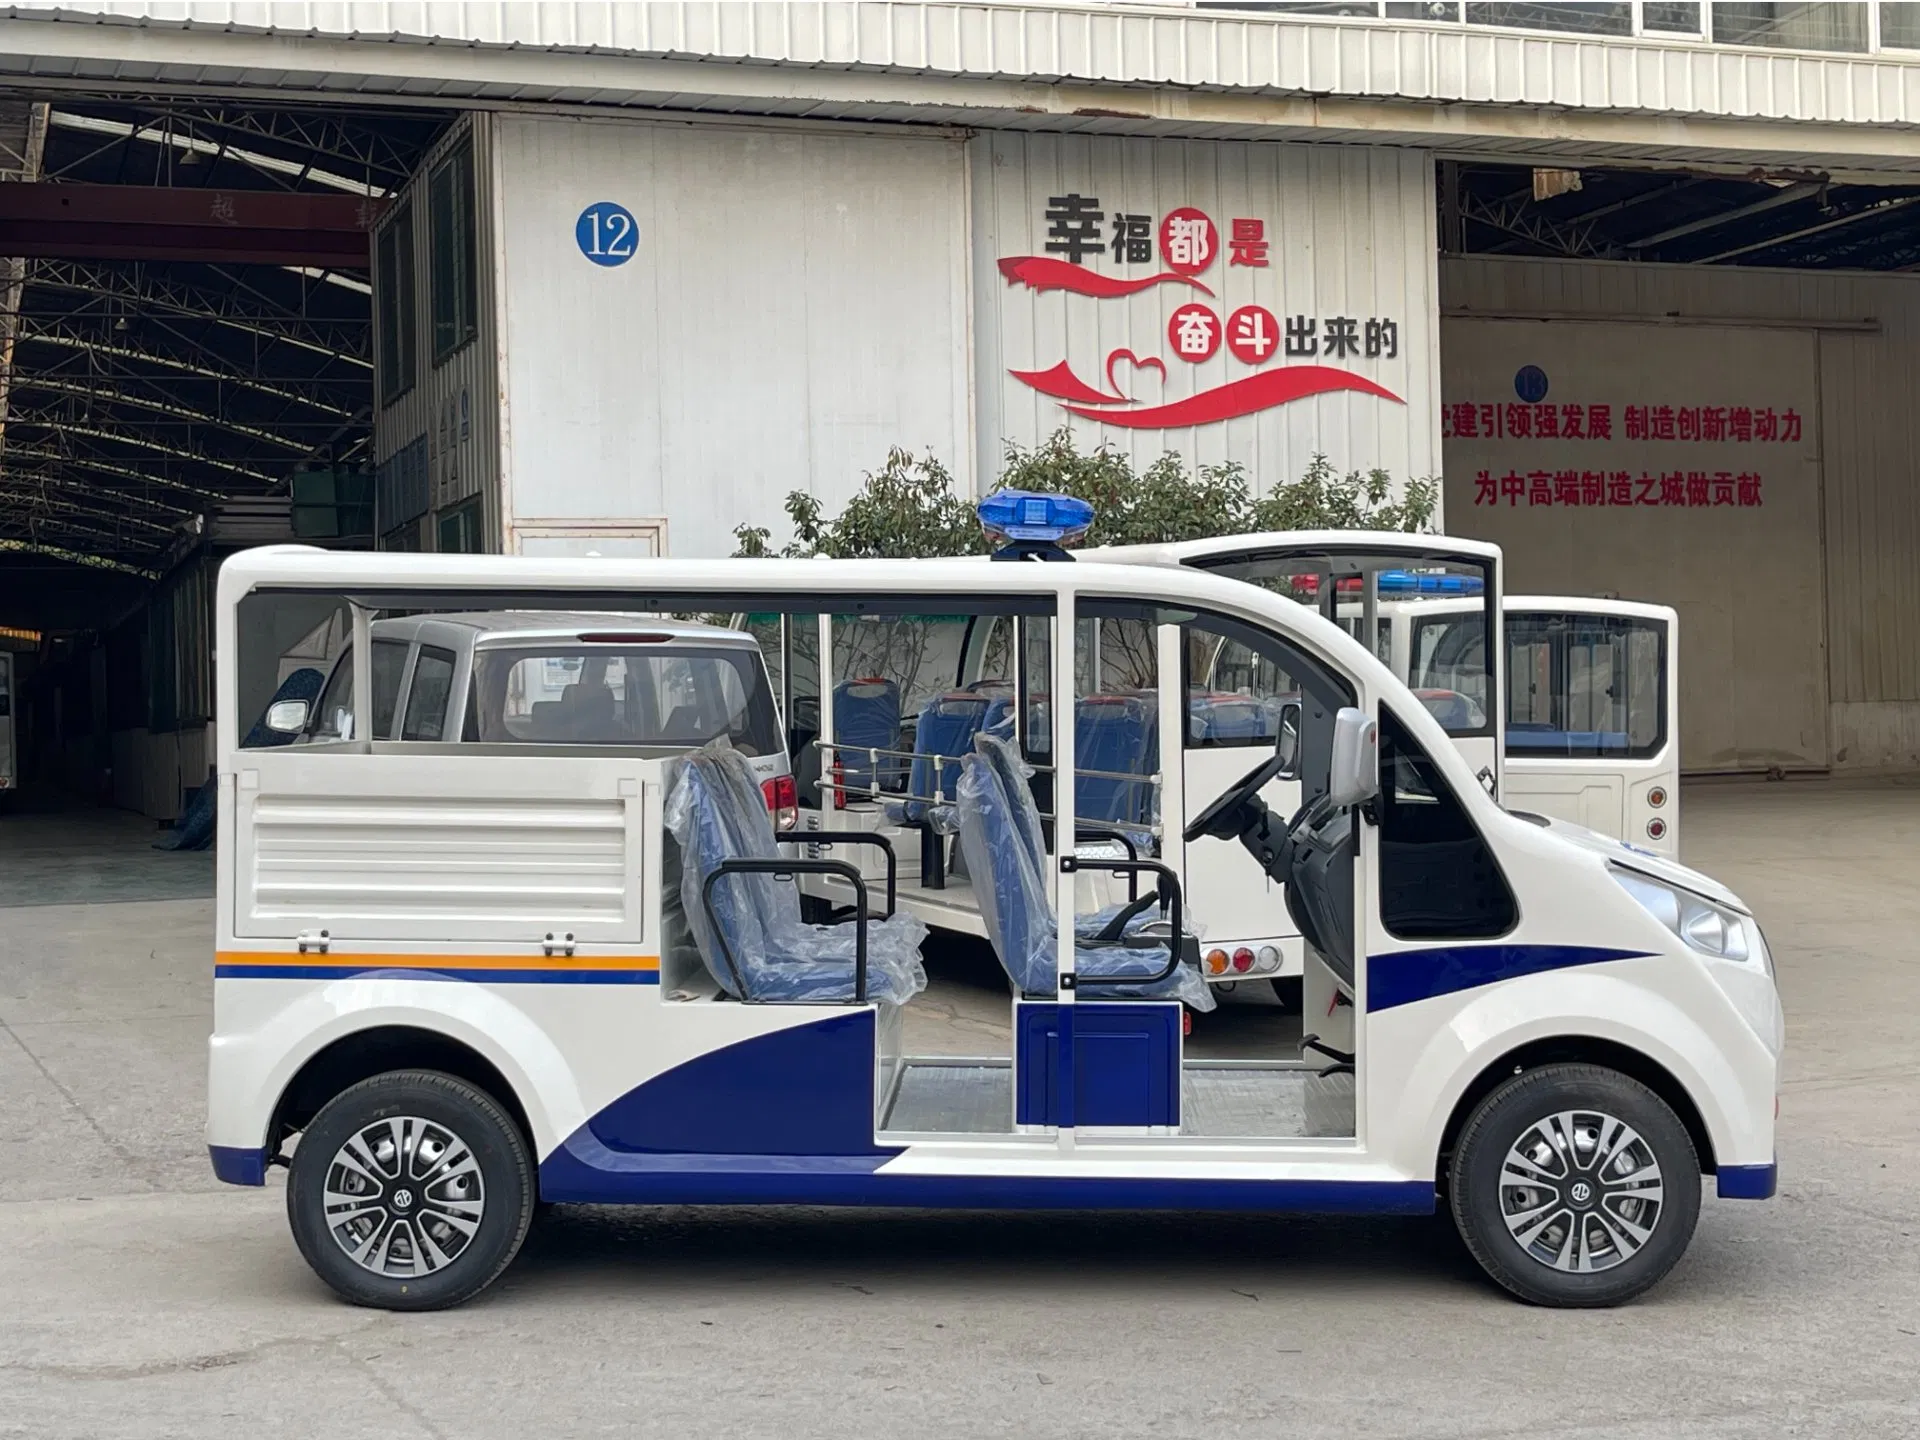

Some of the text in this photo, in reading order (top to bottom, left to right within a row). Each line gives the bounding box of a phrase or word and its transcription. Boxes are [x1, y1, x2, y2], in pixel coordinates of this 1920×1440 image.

[587, 212, 631, 256] 12
[1045, 194, 1270, 267] 幸福都是
[1176, 311, 1397, 359] 奋斗出来的
[1624, 405, 1801, 442] 制造创新增动力
[1474, 470, 1762, 507] 为中高端制造之城做贡献
